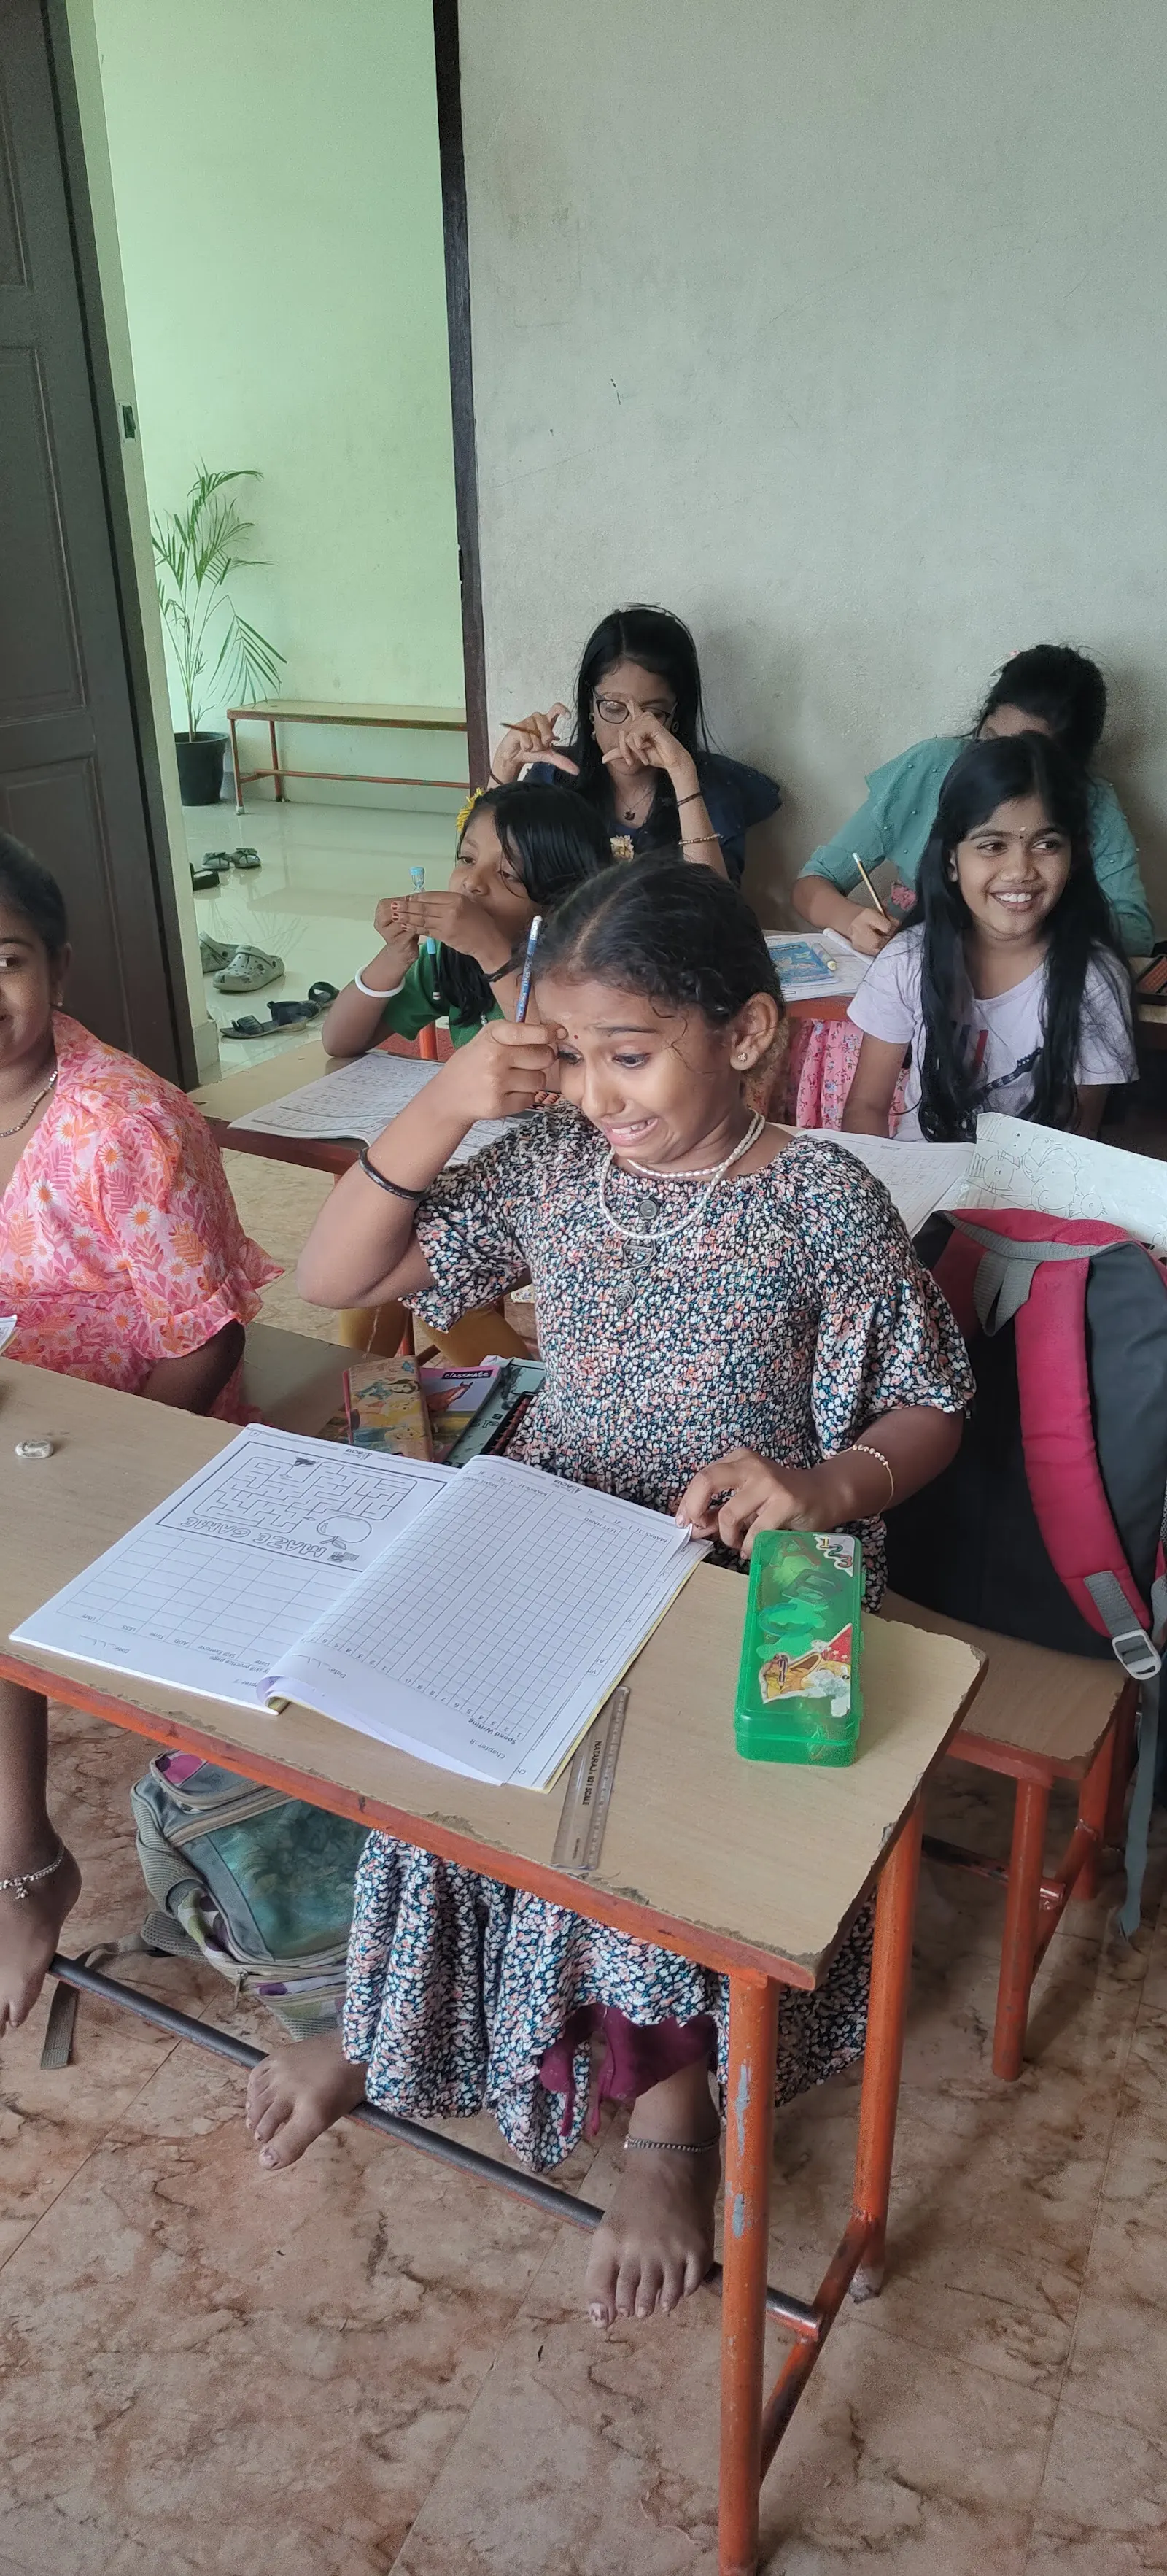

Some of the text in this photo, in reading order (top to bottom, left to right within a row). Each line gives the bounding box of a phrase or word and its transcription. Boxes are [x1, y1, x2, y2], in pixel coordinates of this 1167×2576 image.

[444, 1371, 489, 1379] classmate
[480, 1480, 499, 1488] RIGHT
[583, 1517, 617, 1533] LEFT HAND
[180, 1517, 327, 1558] MAZE GAME
[198, 1646, 223, 1655] Exercise
[225, 1660, 251, 1669] practice
[468, 1718, 517, 1744] Speed Writing
[478, 1743, 506, 1759] Chapter
[589, 1741, 602, 1772] NATARAJ
[582, 1787, 593, 1806] SCALE
